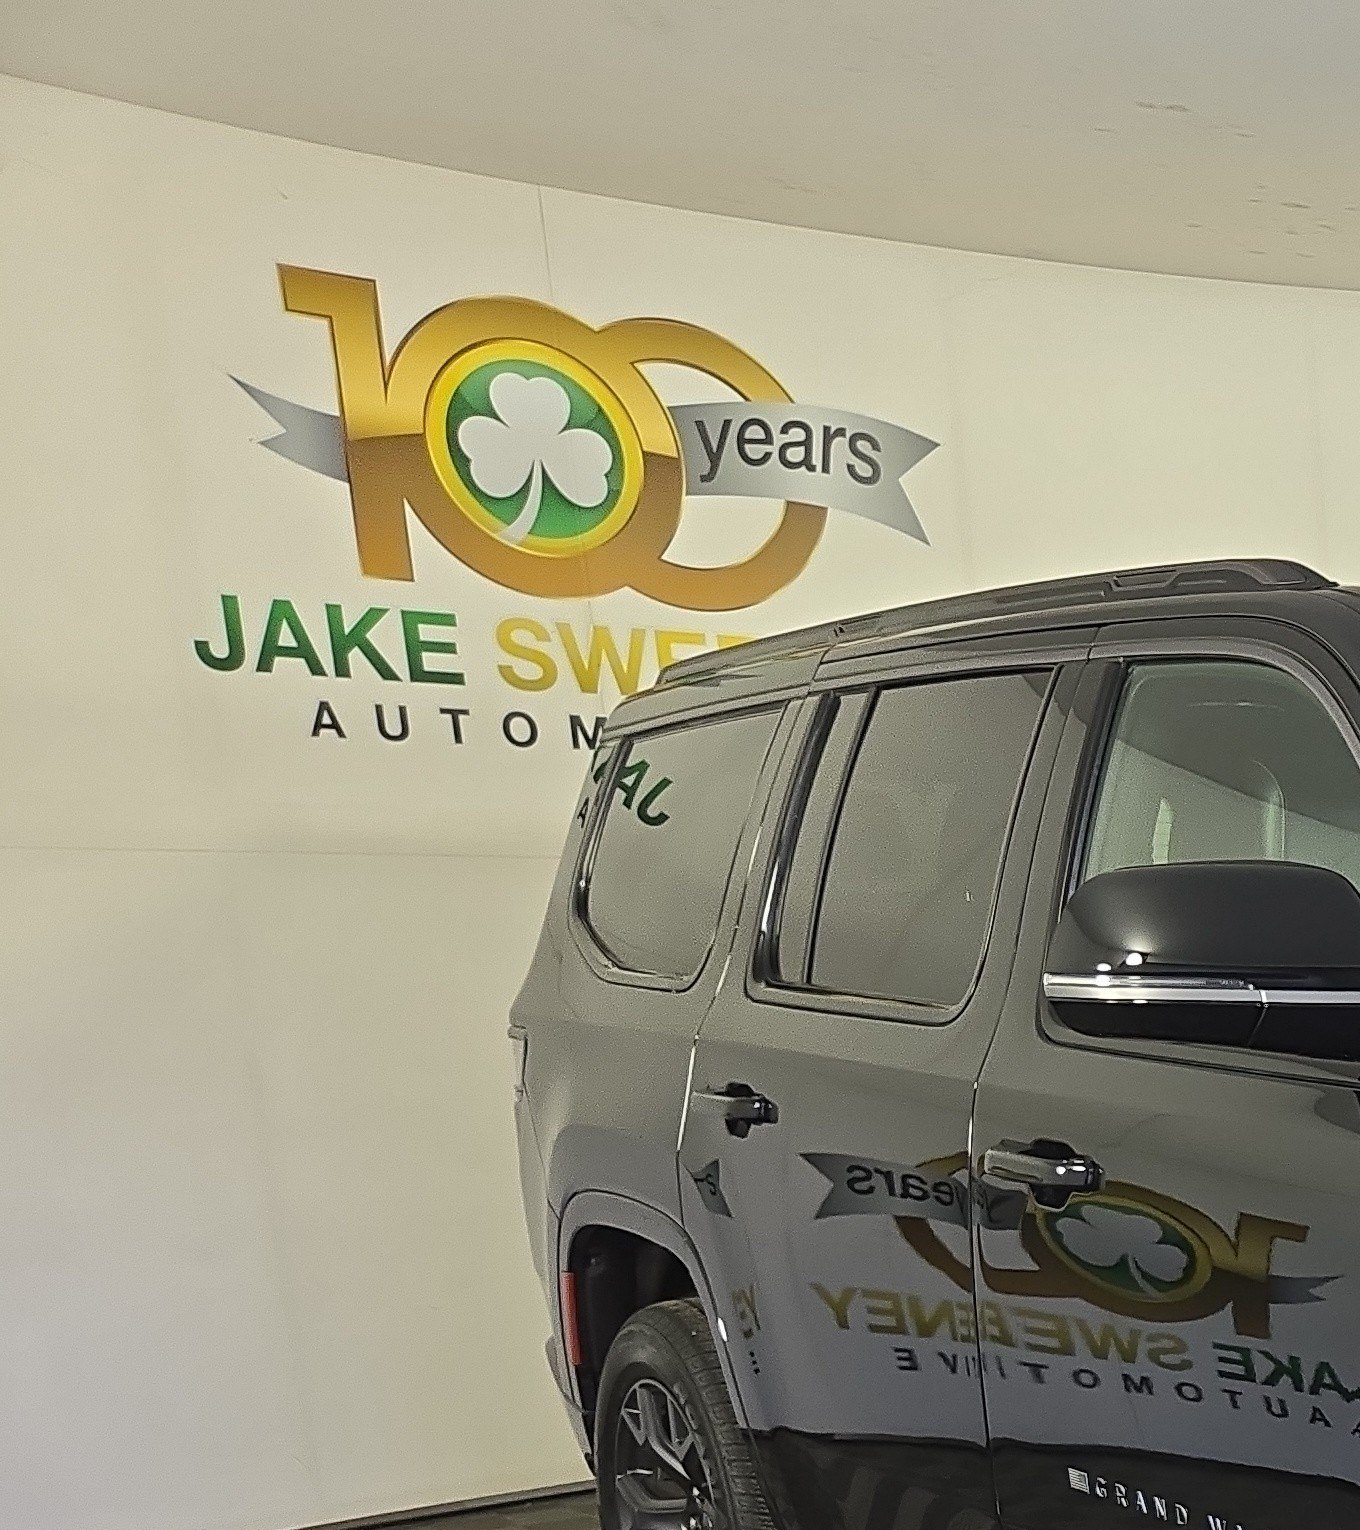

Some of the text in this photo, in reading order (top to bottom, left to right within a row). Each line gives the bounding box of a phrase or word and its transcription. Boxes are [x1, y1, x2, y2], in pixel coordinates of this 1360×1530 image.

[276, 263, 884, 612] 100 years
[194, 593, 466, 687] JAKE
[1095, 1477, 1189, 1526] GRAND
